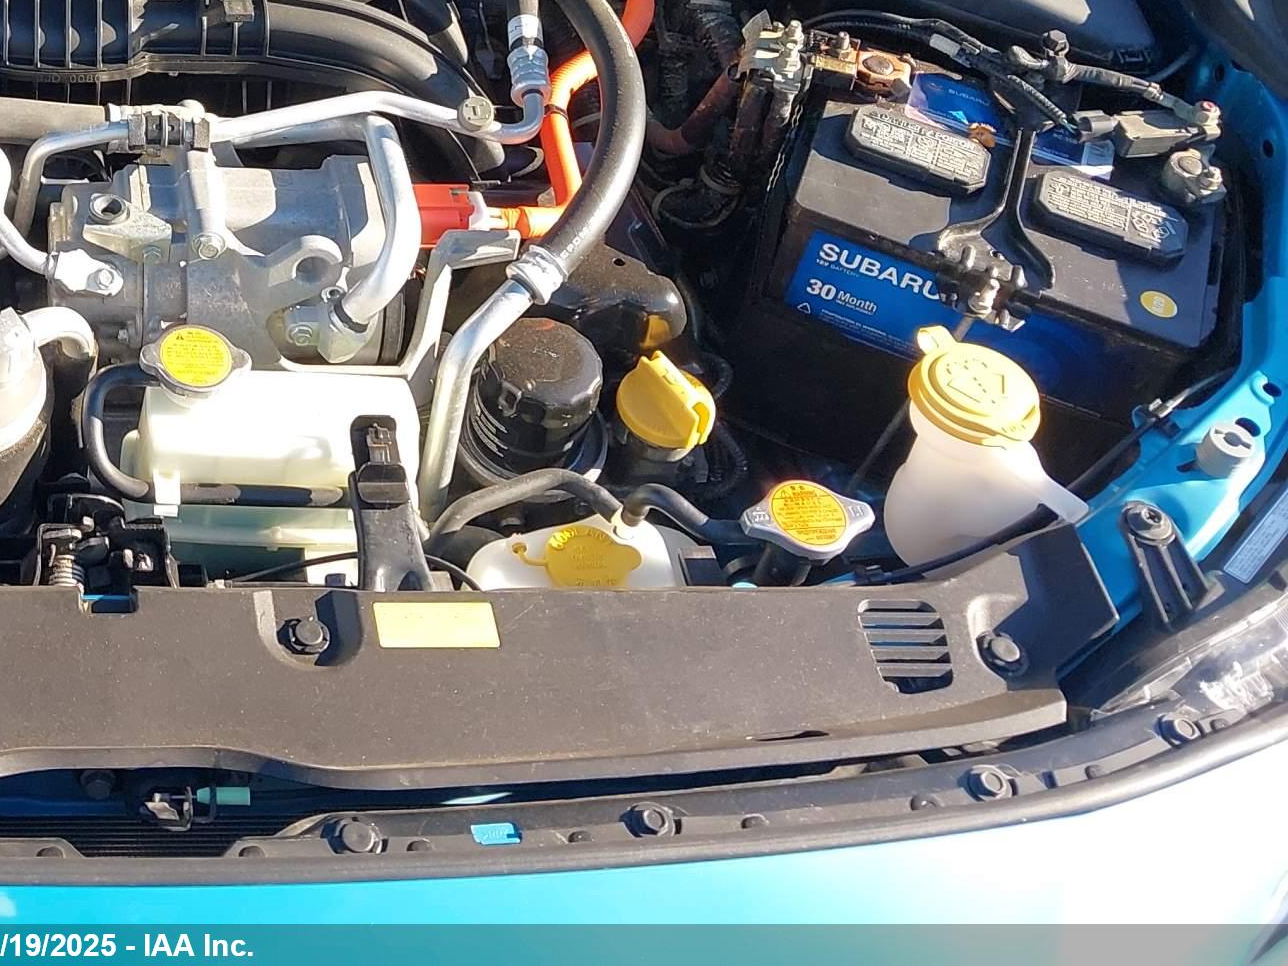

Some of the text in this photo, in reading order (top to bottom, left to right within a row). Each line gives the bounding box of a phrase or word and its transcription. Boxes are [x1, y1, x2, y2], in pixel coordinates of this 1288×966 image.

[947, 88, 991, 107] SUBARU
[818, 242, 946, 302] SUBARU
[806, 278, 837, 300] 30
[837, 290, 877, 313] Month
